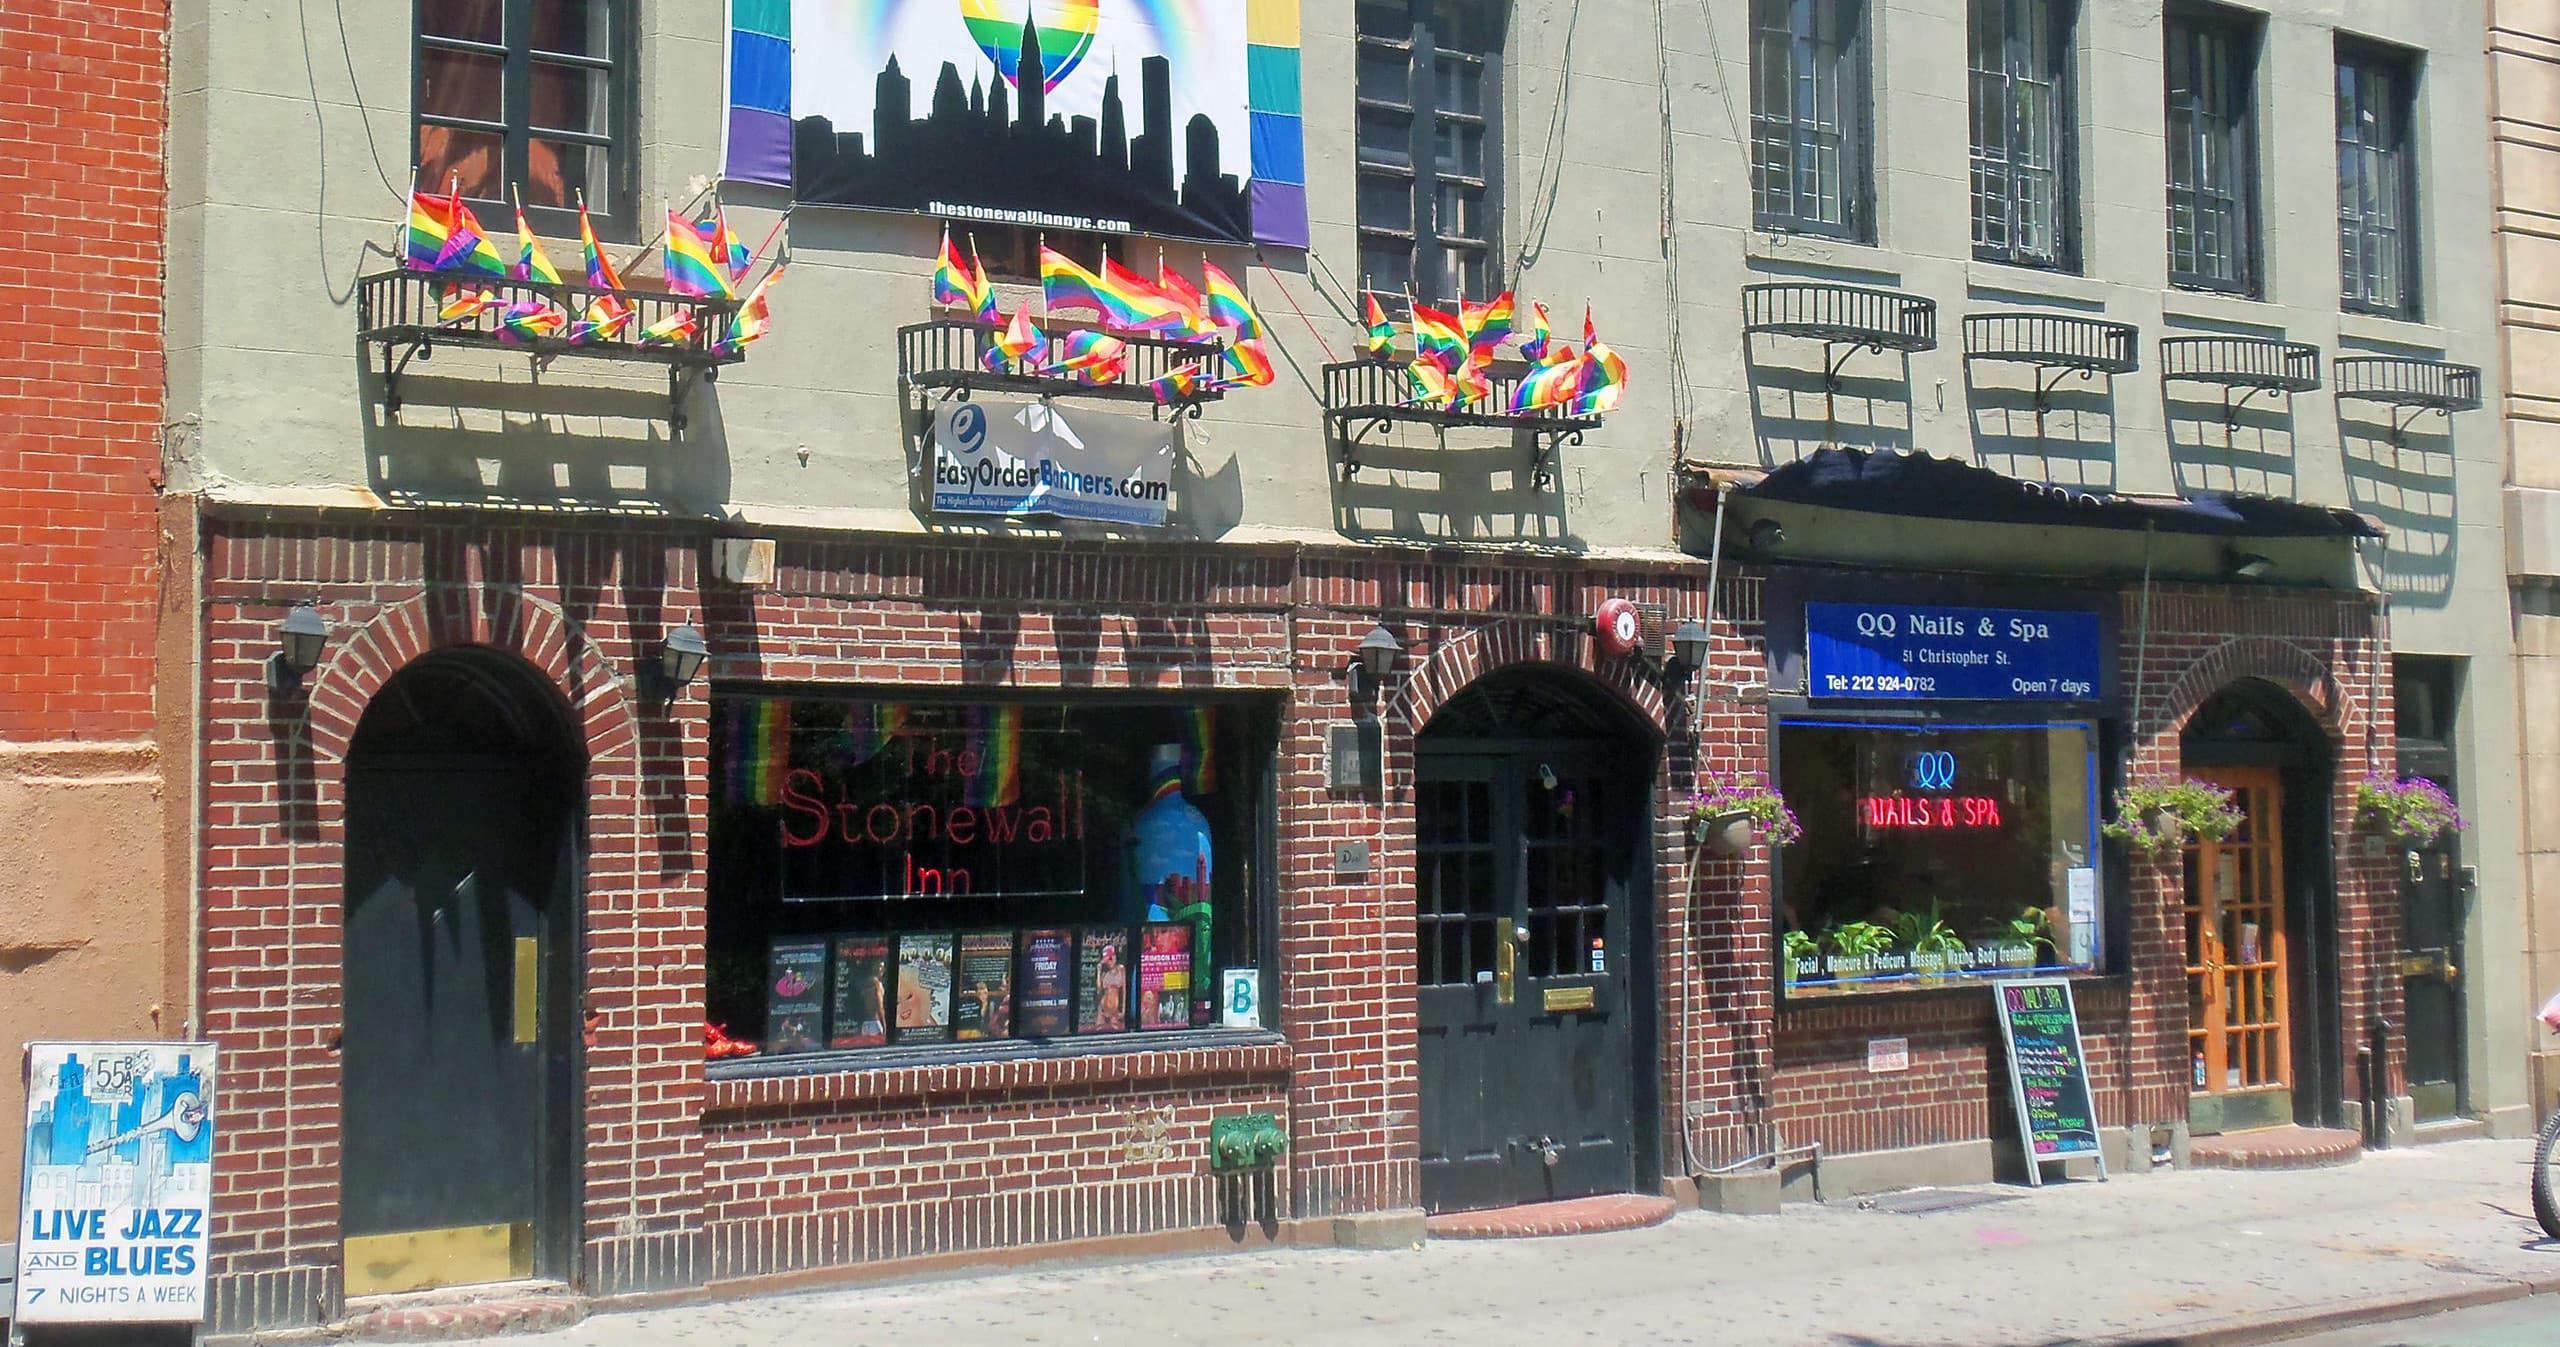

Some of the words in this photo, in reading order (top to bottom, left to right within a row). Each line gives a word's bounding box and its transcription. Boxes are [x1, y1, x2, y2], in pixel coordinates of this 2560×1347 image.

[929, 200, 1131, 232] thestonewallinnnyc.com
[936, 456, 1168, 501] EasyOrderBanners.com
[947, 496, 968, 508] Highest
[1856, 611, 1897, 637] QQ
[1910, 614, 1965, 637] Nails
[1977, 616, 1996, 637] &
[2009, 617, 2049, 642] Spa
[1919, 648, 1989, 666] Christopher
[1995, 650, 2012, 665] St.
[1825, 674, 1847, 691] Tel:
[1851, 675, 1875, 691] 212
[1877, 675, 1936, 691] 924-0782
[2012, 677, 2047, 695] Open
[2049, 678, 2058, 693] 7
[2060, 678, 2091, 696] days
[894, 733, 981, 777] The
[1917, 750, 1956, 790] QQ
[780, 768, 1084, 848] Stonewall
[1870, 797, 1930, 827] NAILS
[1941, 797, 1954, 828] &
[1963, 797, 2001, 827] SPA
[905, 851, 971, 895] Inn
[1034, 961, 1058, 971] FRIDAY
[1795, 956, 1819, 975] Facial
[1826, 954, 1861, 973] Manicure
[1872, 952, 1906, 970] Pedicure
[1977, 946, 1997, 967] Body
[1232, 978, 1252, 1013] B
[96, 1059, 125, 1089] 55
[124, 1056, 133, 1097] BAR
[32, 1208, 107, 1241] LIVE
[120, 1208, 203, 1241] JAZZ
[27, 1254, 77, 1268] AND
[84, 1245, 197, 1277] BLUES
[26, 1288, 47, 1305] 7
[60, 1286, 129, 1304] NIGHTS
[137, 1287, 147, 1303] A
[154, 1285, 197, 1304] WEEK
